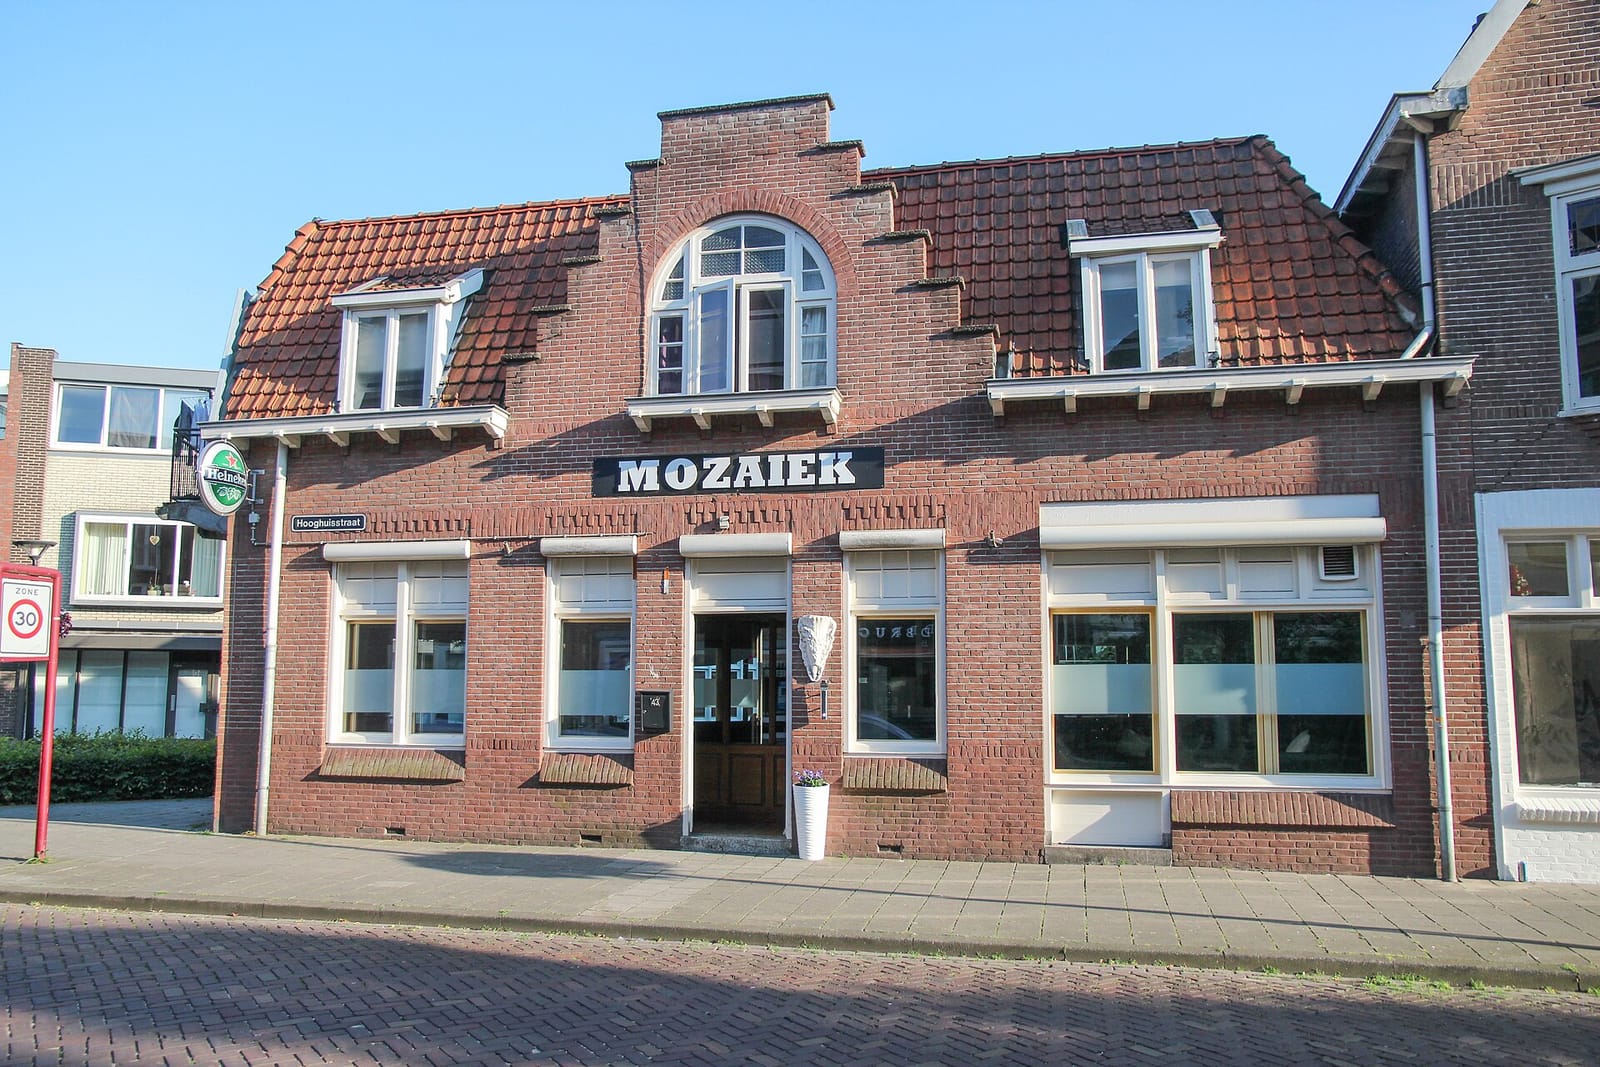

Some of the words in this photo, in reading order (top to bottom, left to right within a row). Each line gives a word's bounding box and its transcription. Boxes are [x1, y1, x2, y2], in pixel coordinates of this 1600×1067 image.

[206, 468, 246, 485] Heineke
[617, 451, 856, 492] MOZAIEK
[296, 518, 361, 529] Hooghuisstraat
[15, 587, 40, 596] ZONE
[15, 611, 37, 627] 30
